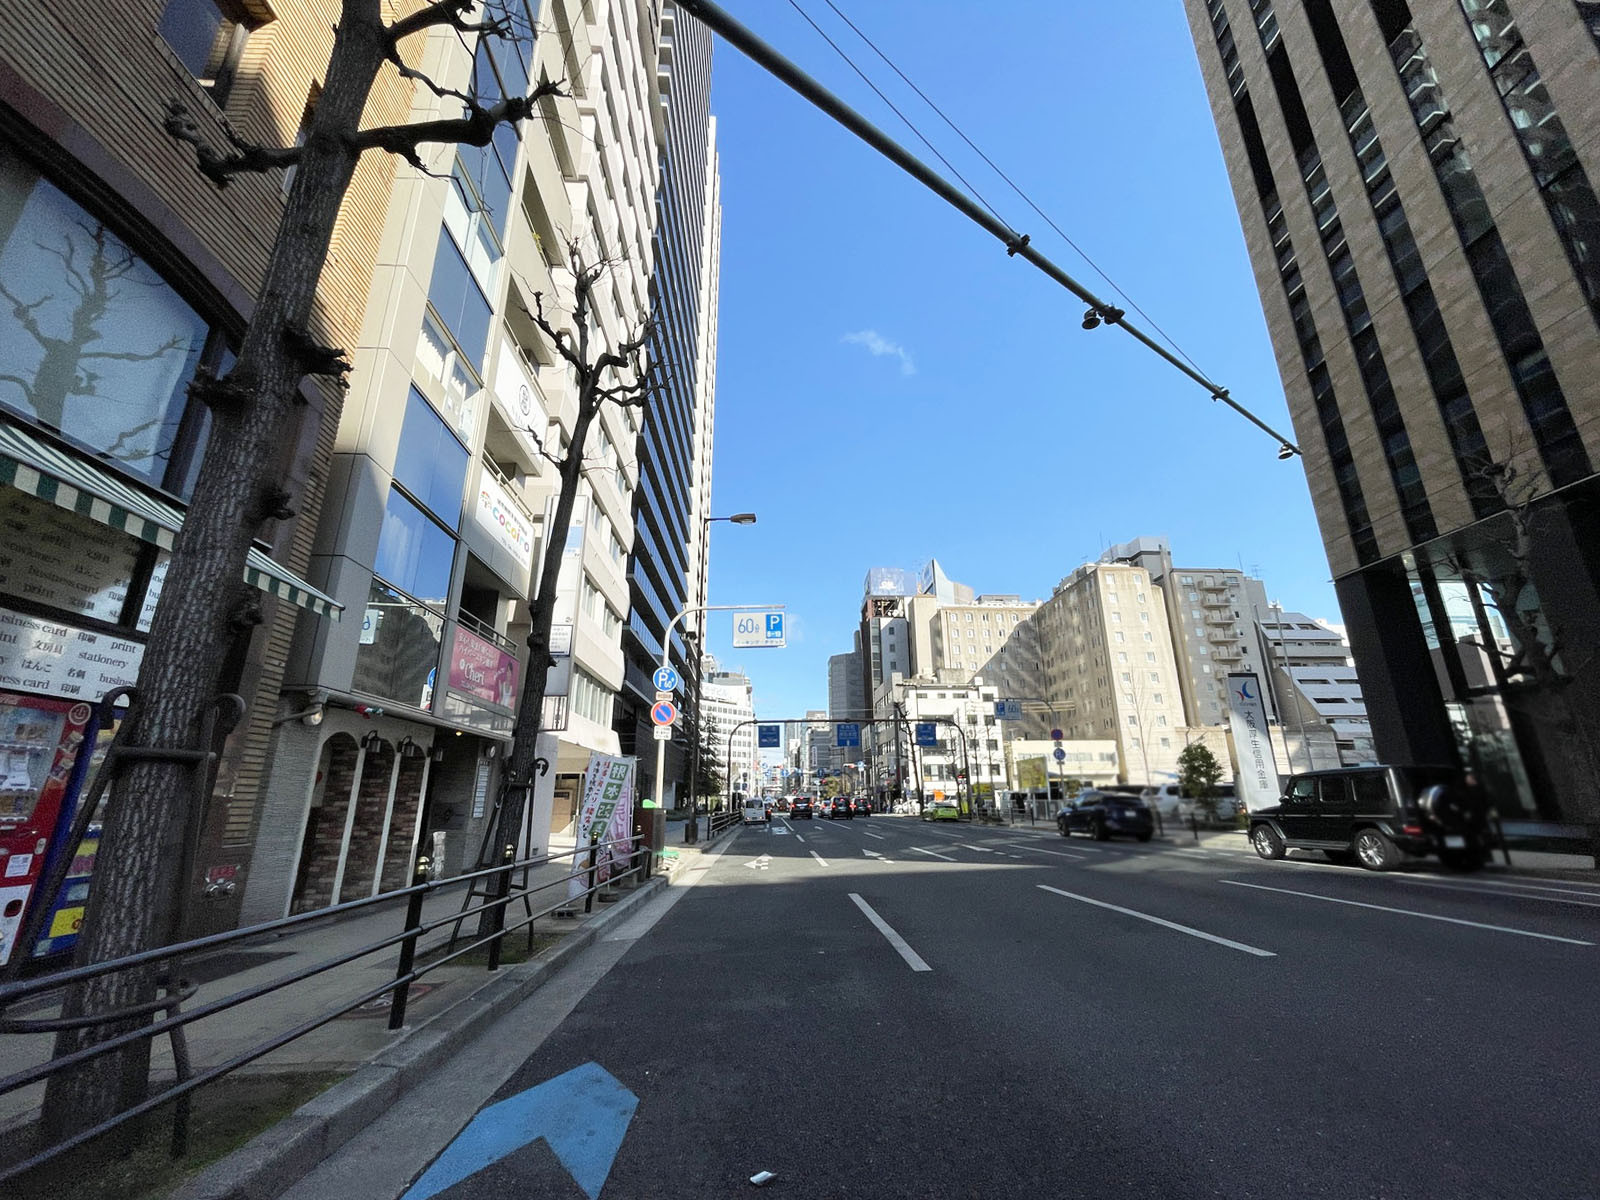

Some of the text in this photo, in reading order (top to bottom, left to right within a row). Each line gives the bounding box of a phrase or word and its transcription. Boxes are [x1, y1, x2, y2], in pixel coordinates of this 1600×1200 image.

[770, 615, 781, 630] P
[41, 625, 68, 638] card
[77, 631, 98, 645] 印刷
[110, 640, 137, 654] print
[21, 659, 53, 674] はんこ
[79, 651, 129, 669] stationery
[22, 679, 51, 690] card
[658, 672, 669, 688] P
[60, 683, 81, 696] 印刷
